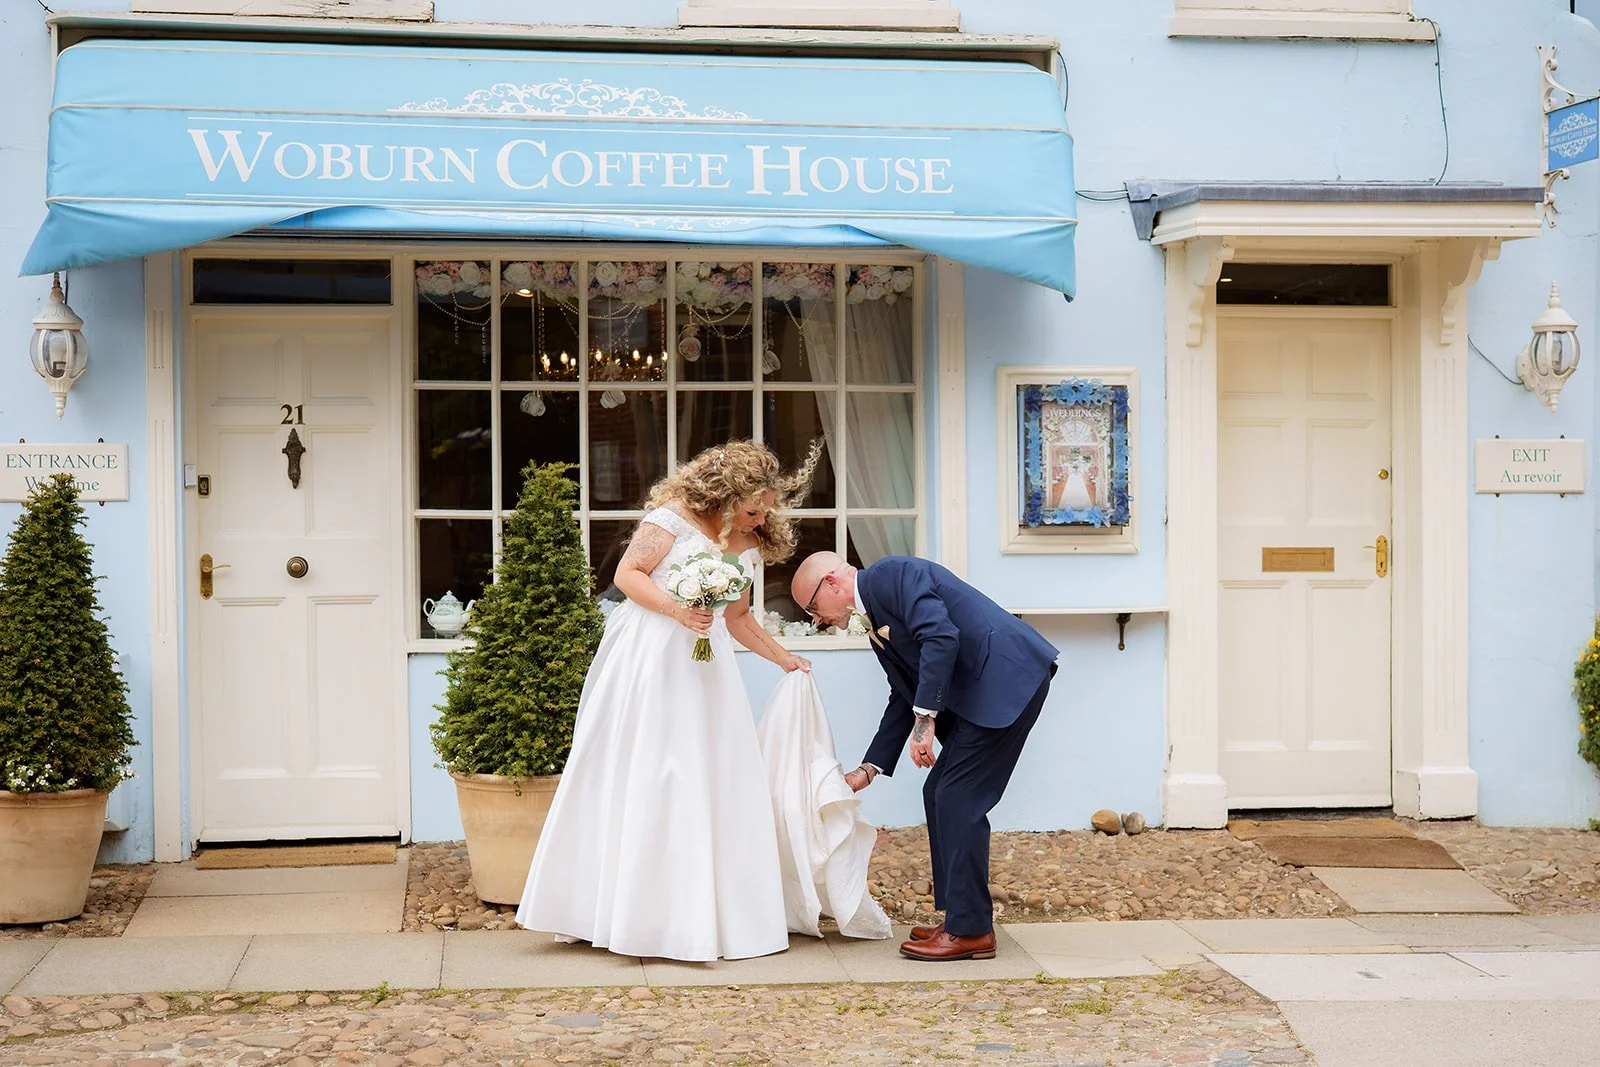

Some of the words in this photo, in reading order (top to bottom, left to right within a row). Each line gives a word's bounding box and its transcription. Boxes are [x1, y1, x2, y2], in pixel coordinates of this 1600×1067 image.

[187, 129, 479, 185] WOBURN
[495, 140, 731, 193] COFFEE
[745, 144, 955, 198] HOUSE
[280, 403, 306, 426] 21
[1050, 409, 1101, 418] WEDDINGS
[6, 453, 118, 469] ENTRANCE
[1512, 449, 1551, 462] EXIT
[1501, 470, 1520, 483] Au
[1524, 469, 1562, 483] revoir
